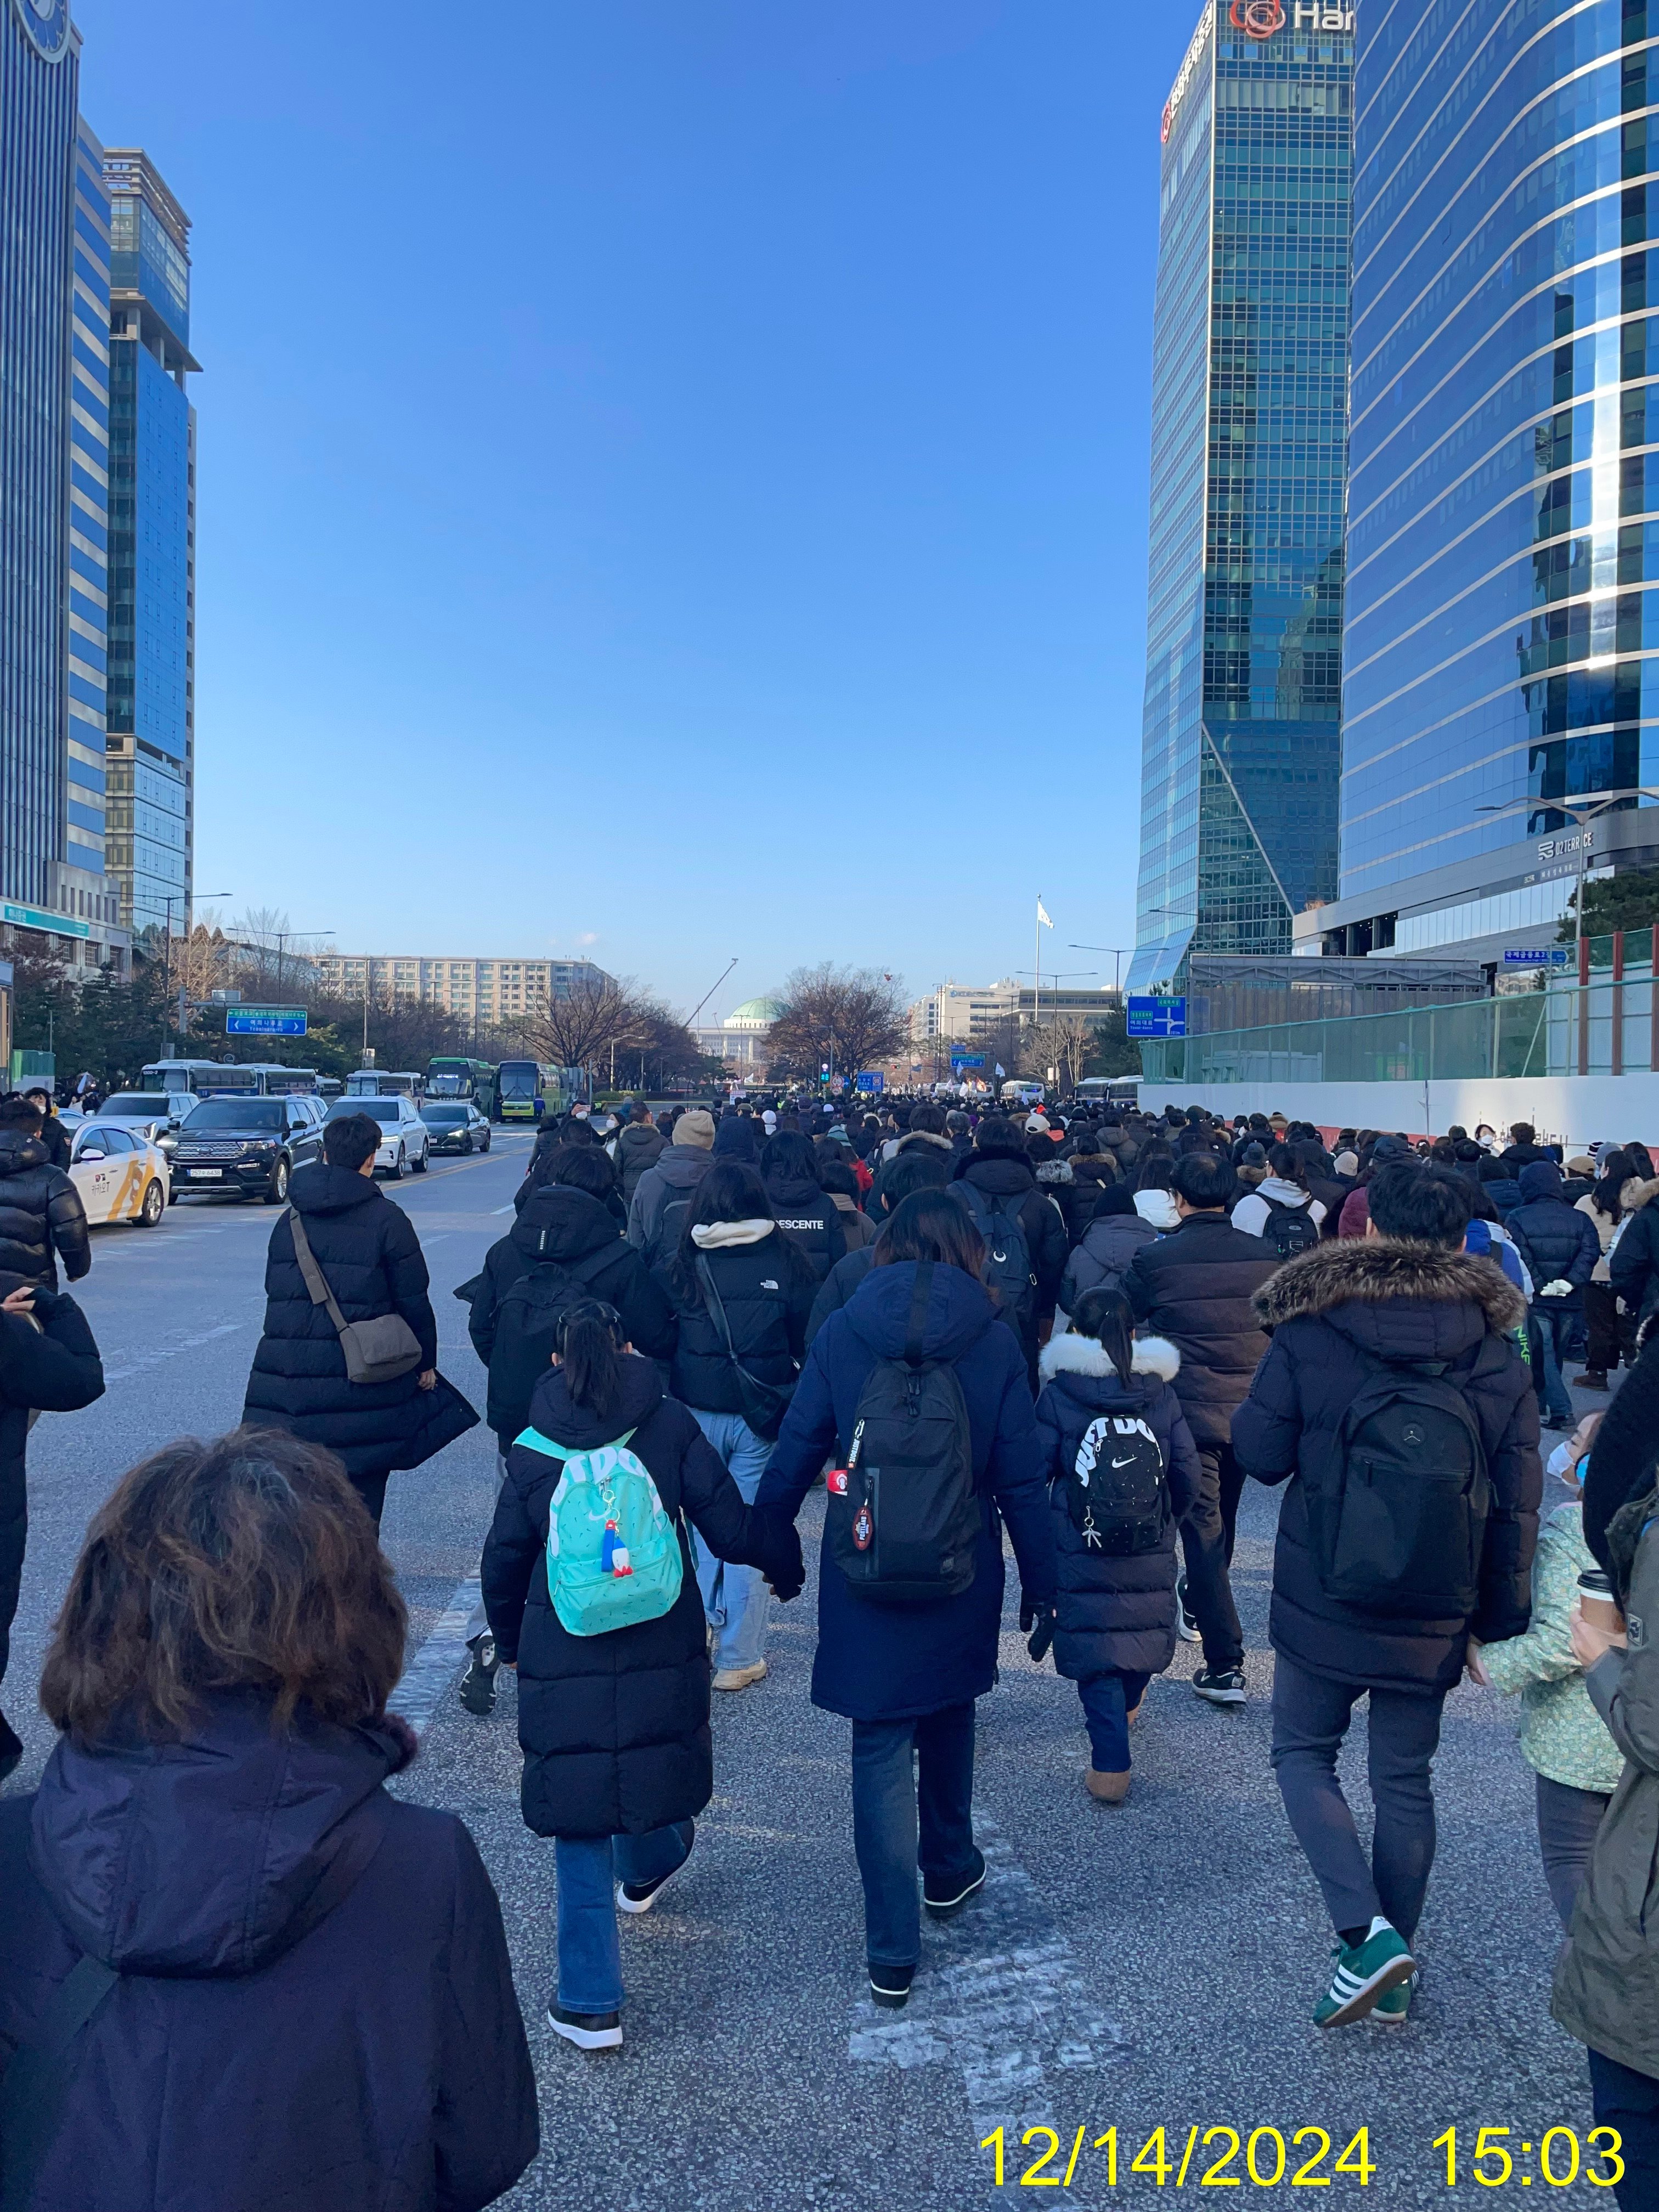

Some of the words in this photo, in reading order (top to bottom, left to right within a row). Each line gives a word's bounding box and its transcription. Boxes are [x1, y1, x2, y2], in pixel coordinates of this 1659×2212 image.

[1556, 832, 1592, 855] O2TERRCE
[91, 1181, 110, 1197] 카카오T
[775, 1220, 824, 1229] ESCENTE
